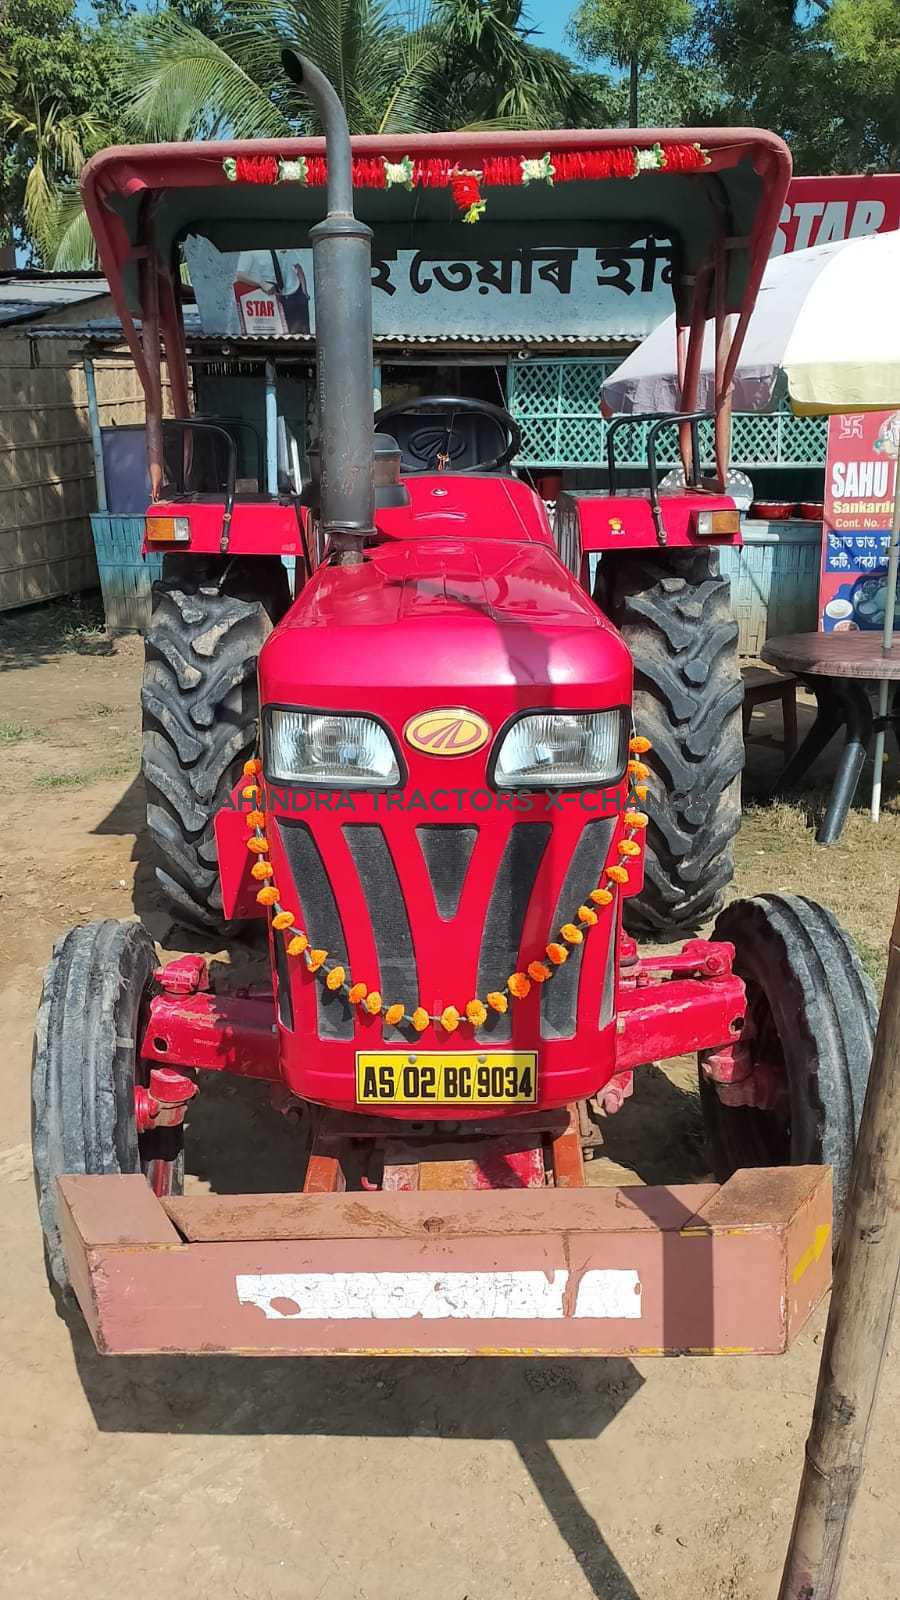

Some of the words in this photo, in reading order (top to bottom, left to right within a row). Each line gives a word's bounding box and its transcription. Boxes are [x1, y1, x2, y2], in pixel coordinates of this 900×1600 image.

[768, 201, 886, 260] STAR
[246, 300, 275, 317] STAR
[831, 461, 889, 498] SAHU
[835, 518, 861, 528] Cont.
[864, 518, 880, 528] No.
